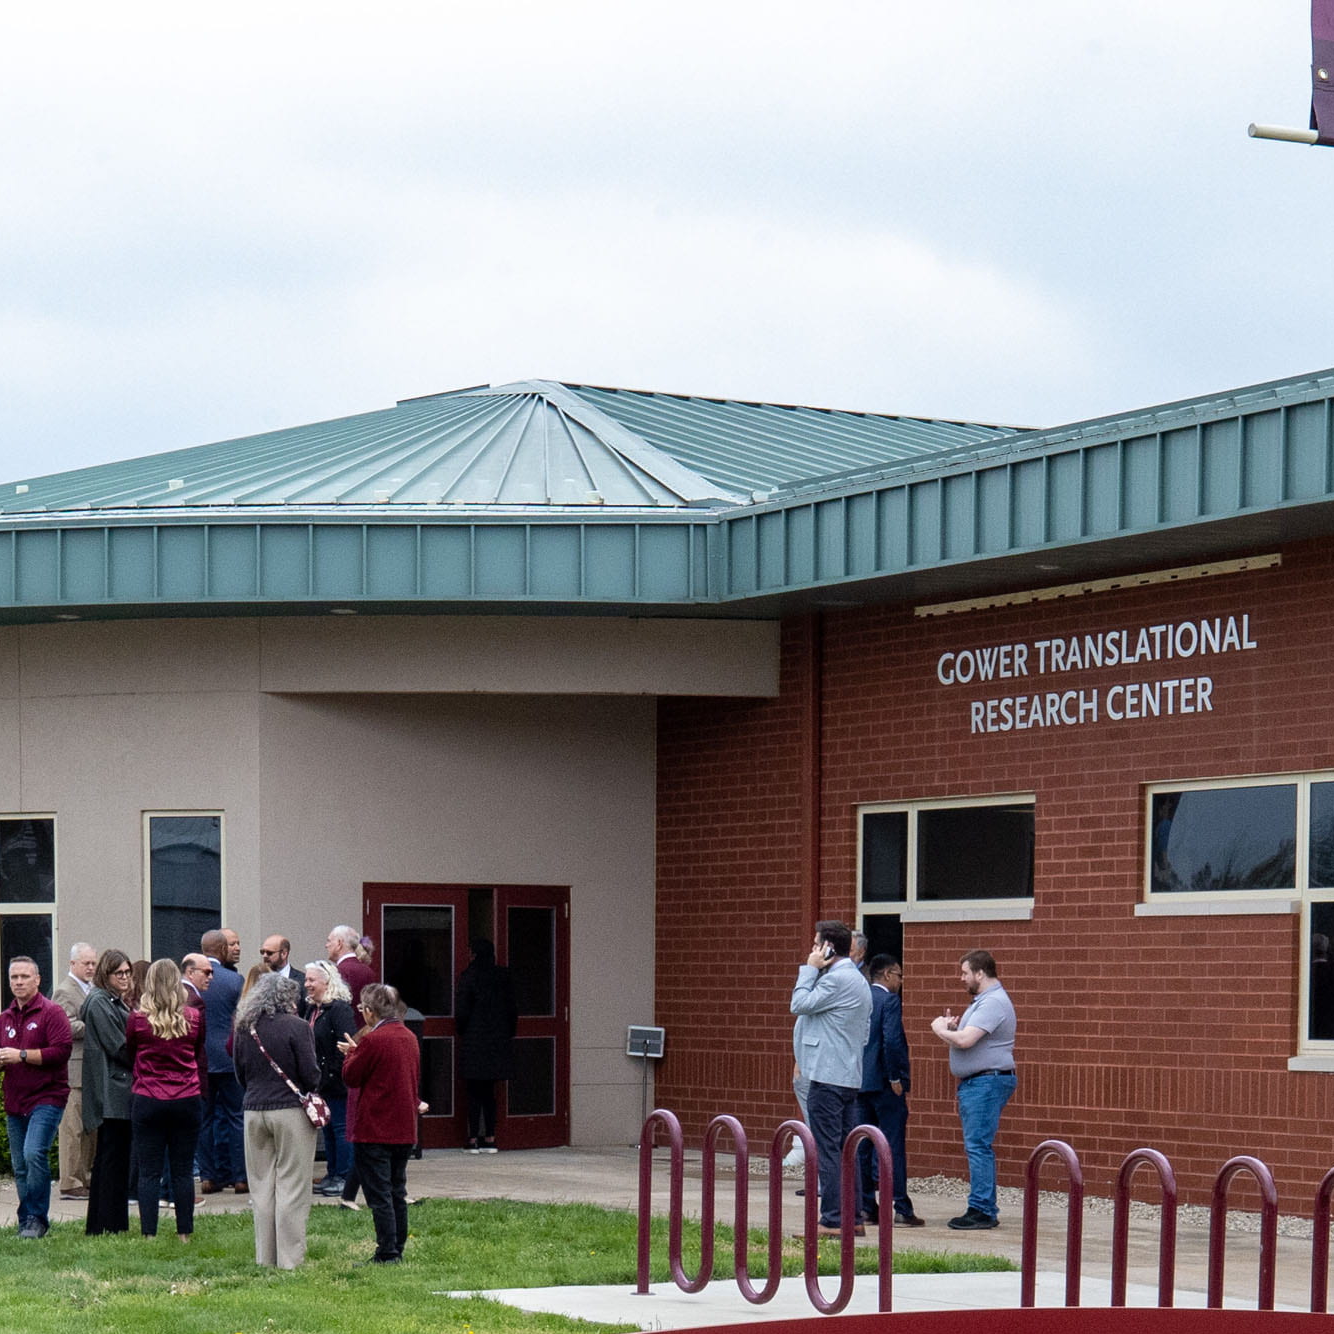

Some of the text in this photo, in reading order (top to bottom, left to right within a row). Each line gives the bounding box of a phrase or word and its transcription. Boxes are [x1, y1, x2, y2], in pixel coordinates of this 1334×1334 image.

[937, 614, 1258, 686] GOWER TRANSLATIONAL
[970, 676, 1213, 734] RESEARCH CENTER
